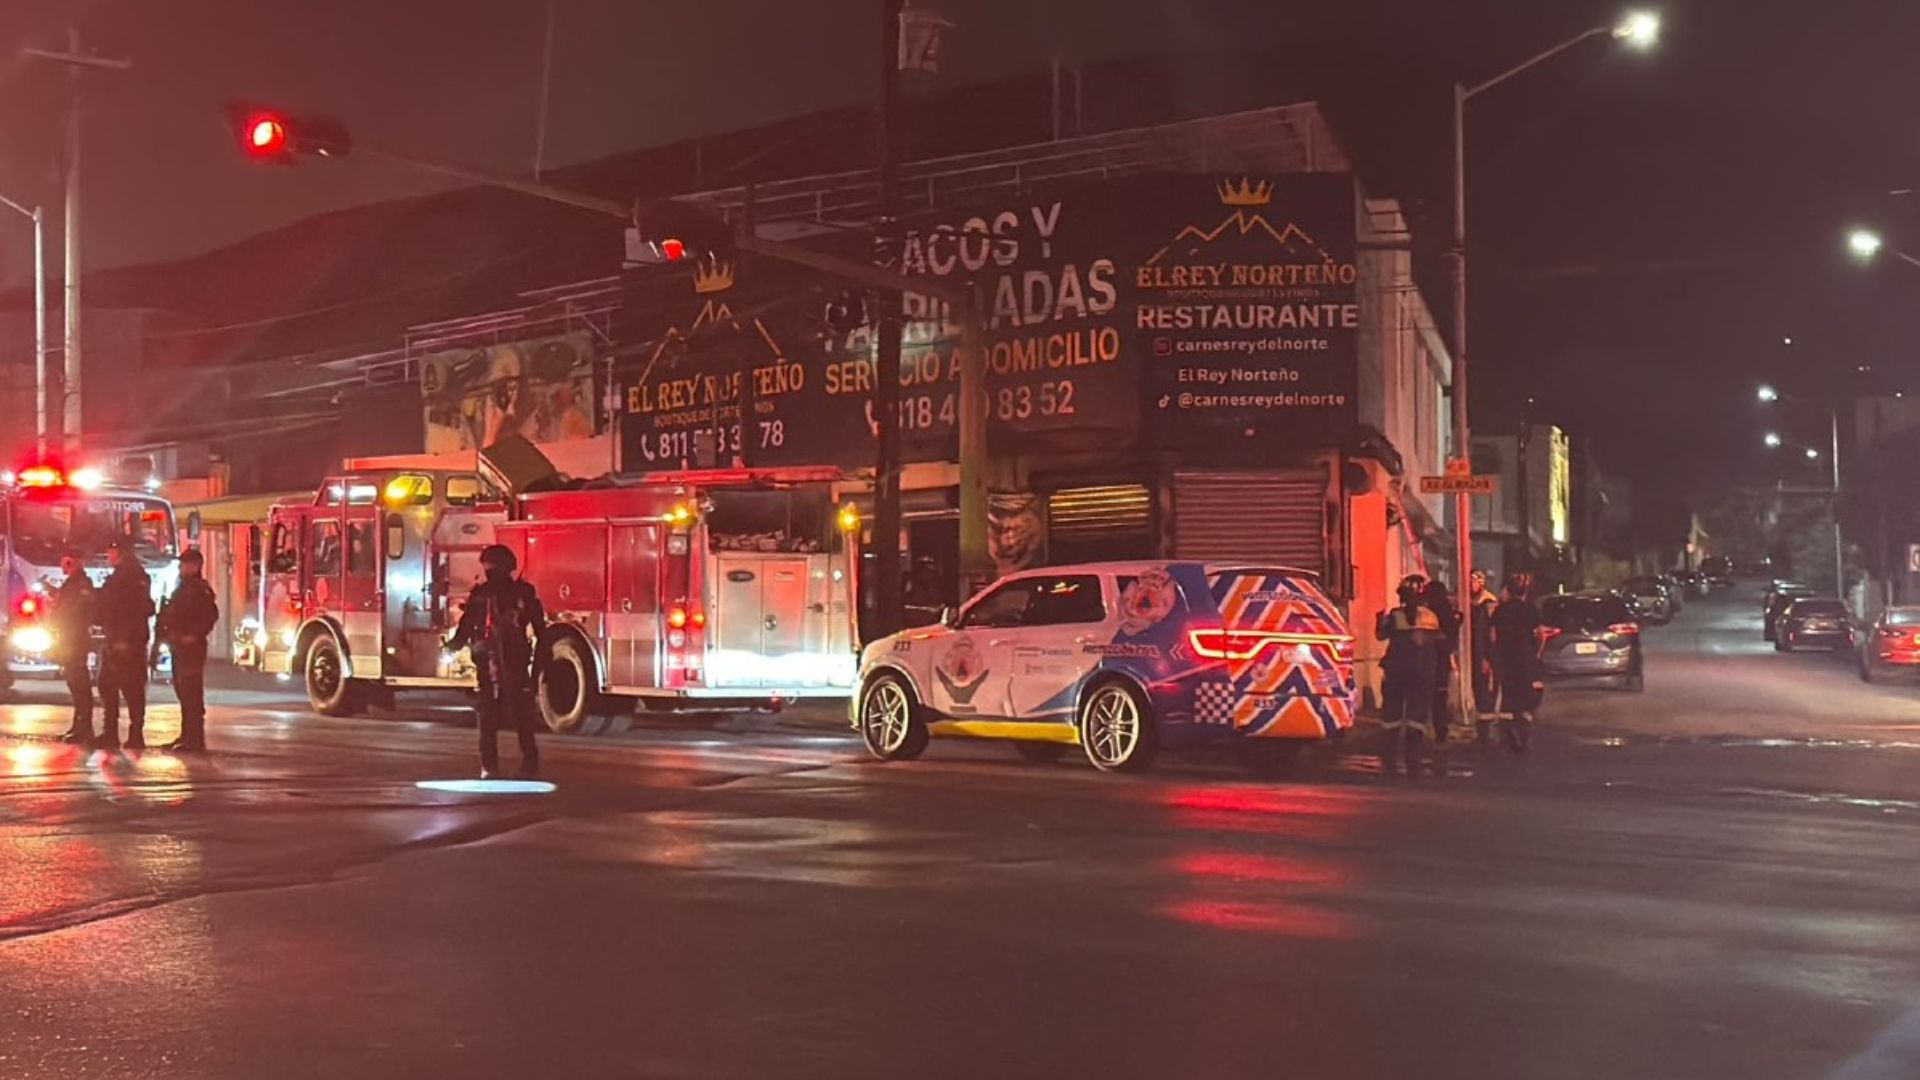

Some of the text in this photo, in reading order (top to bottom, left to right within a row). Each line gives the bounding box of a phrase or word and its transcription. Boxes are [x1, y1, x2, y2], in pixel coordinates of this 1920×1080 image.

[902, 202, 1061, 276] ACOS Y
[1232, 259, 1356, 286] NORTEÑO
[1137, 304, 1359, 329] RESTAURANTE
[1176, 337, 1328, 354] carnesreydelnorte
[1178, 368, 1299, 384] El Rey Norteño
[627, 385, 653, 413] EL
[658, 372, 702, 410] REY
[998, 385, 1031, 421] 83
[1041, 379, 1075, 416] 52
[1178, 392, 1345, 408] @carnesreydelnorte
[659, 431, 689, 460] 811
[759, 420, 784, 449] 78
